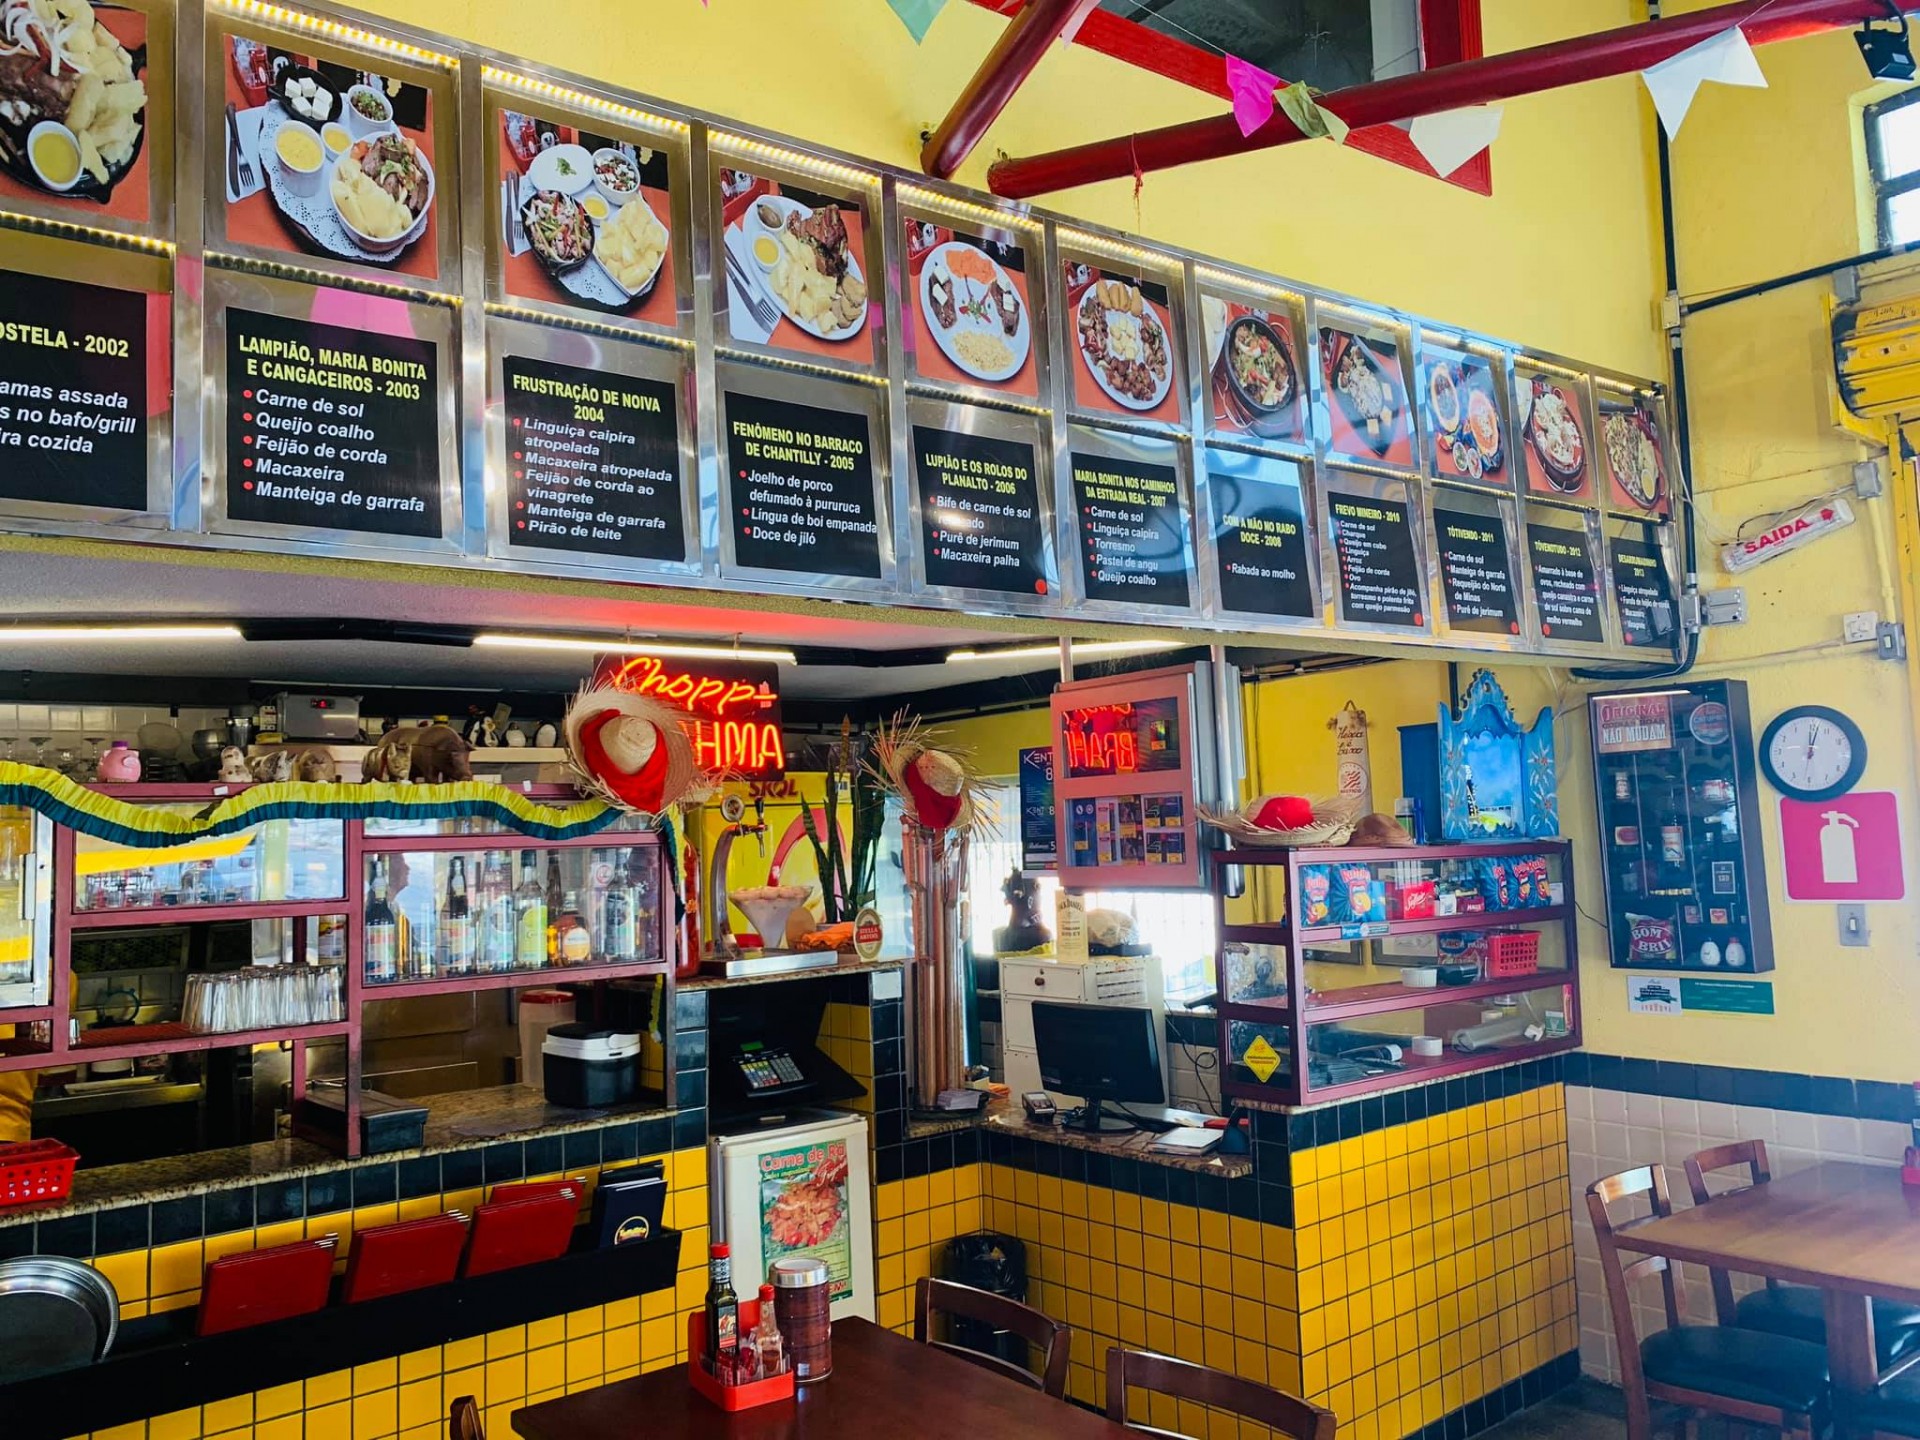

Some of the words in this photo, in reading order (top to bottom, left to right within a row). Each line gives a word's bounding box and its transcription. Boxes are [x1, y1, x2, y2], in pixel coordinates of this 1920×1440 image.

[85, 335, 128, 358] 2002
[240, 335, 315, 365] LAMPIÃO,
[319, 349, 368, 371] MARIA
[372, 357, 427, 380] BONITA
[248, 359, 257, 376] E
[262, 361, 373, 393] CANGACEIROS
[386, 380, 420, 400] 2003
[59, 389, 128, 409] assada
[255, 389, 308, 410] Carne
[312, 398, 333, 414] de
[338, 402, 364, 418] sol
[513, 374, 599, 404] FRUSTRAÇÃO
[602, 390, 619, 405] DE
[622, 393, 661, 413] NOIVA
[17, 408, 42, 422] no
[48, 409, 136, 434] bafo/grill
[574, 405, 605, 424] 2004
[255, 412, 313, 437] Queijo
[317, 420, 375, 441] coalho
[524, 418, 585, 439] Linguiça
[589, 428, 635, 445] caipira
[28, 435, 93, 453] cozida
[524, 436, 600, 457] atropelada
[733, 421, 793, 445] FENÔMENO
[796, 431, 812, 447] NO
[814, 433, 863, 455] BARRACO
[255, 434, 309, 459] Feijão
[314, 444, 336, 460] de
[340, 446, 387, 465] corda
[745, 442, 760, 457] DE
[762, 445, 822, 467] CHANTILLY
[830, 453, 854, 471] 2005
[255, 458, 345, 482] Macaxeira
[525, 452, 598, 473] Macaxeira
[601, 462, 672, 483] atropelada
[926, 453, 959, 470] LUPIÃO
[961, 459, 967, 471] E
[970, 461, 982, 473] OS
[984, 463, 1013, 478] ROLOS
[1015, 467, 1027, 481] DO
[525, 469, 570, 487] Feijão
[573, 475, 591, 490] de
[595, 478, 634, 496] corda
[637, 484, 654, 497] ao
[748, 470, 784, 487] Joelho
[787, 474, 801, 489] de
[803, 479, 833, 493] porco
[942, 474, 988, 491] PLANALTO
[995, 480, 1016, 495] 2006
[1099, 473, 1123, 486] BONITA
[1125, 476, 1139, 488] NOS
[1140, 478, 1175, 494] CAMINHOS
[255, 481, 336, 507] Manteiga
[340, 489, 362, 506] de
[365, 493, 425, 513] garrafa
[527, 487, 594, 507] vinagrete
[749, 488, 803, 508] defumado
[805, 493, 813, 508] à
[815, 499, 861, 515] pururuca
[1086, 487, 1096, 499] DA
[1097, 488, 1128, 503] ESTRADA
[1129, 493, 1145, 505] REAL
[528, 504, 594, 525] Manteiga
[597, 510, 614, 525] de
[617, 514, 666, 530] garrafa
[937, 496, 957, 509] Bife
[959, 498, 972, 511] de
[973, 500, 1001, 515] carne
[1002, 503, 1016, 516] de
[1017, 505, 1031, 519] sol
[1091, 506, 1116, 520] Carne
[1118, 510, 1129, 521] de
[1131, 512, 1143, 522] sol
[528, 520, 567, 537] Pirão
[570, 524, 589, 538] de
[592, 526, 622, 542] leite
[751, 507, 789, 527] Língua
[791, 512, 804, 526] de
[806, 513, 824, 528] boi
[826, 517, 877, 535] empanada
[1092, 522, 1129, 537] Linguiça
[1131, 528, 1159, 540] caipira
[1241, 517, 1246, 528] A
[1264, 521, 1274, 532] NO
[1276, 523, 1296, 535] RABO
[752, 526, 781, 542] Doce
[783, 529, 797, 543] de
[798, 530, 816, 547] jiló
[940, 531, 964, 544] Purê
[965, 533, 978, 545] de
[979, 535, 1019, 551] jerimum
[1094, 538, 1135, 552] Torresmo
[1240, 531, 1260, 544] DOCE
[941, 548, 991, 564] Macaxeira
[993, 553, 1020, 567] palha
[1096, 554, 1123, 568] Pastel
[1125, 557, 1136, 569] de
[1137, 561, 1158, 571] angu
[1098, 570, 1126, 585] Queijo
[1128, 573, 1156, 586] coalho
[1232, 563, 1259, 576] Rabada
[1261, 569, 1270, 577] ao
[1272, 569, 1296, 579] molho
[1627, 724, 1666, 742] MUDAM
[1024, 750, 1053, 769] KENT
[748, 777, 799, 798] SKOL
[1632, 927, 1663, 940] BOM
[761, 1153, 804, 1172] Carne
[808, 1146, 824, 1163] de
